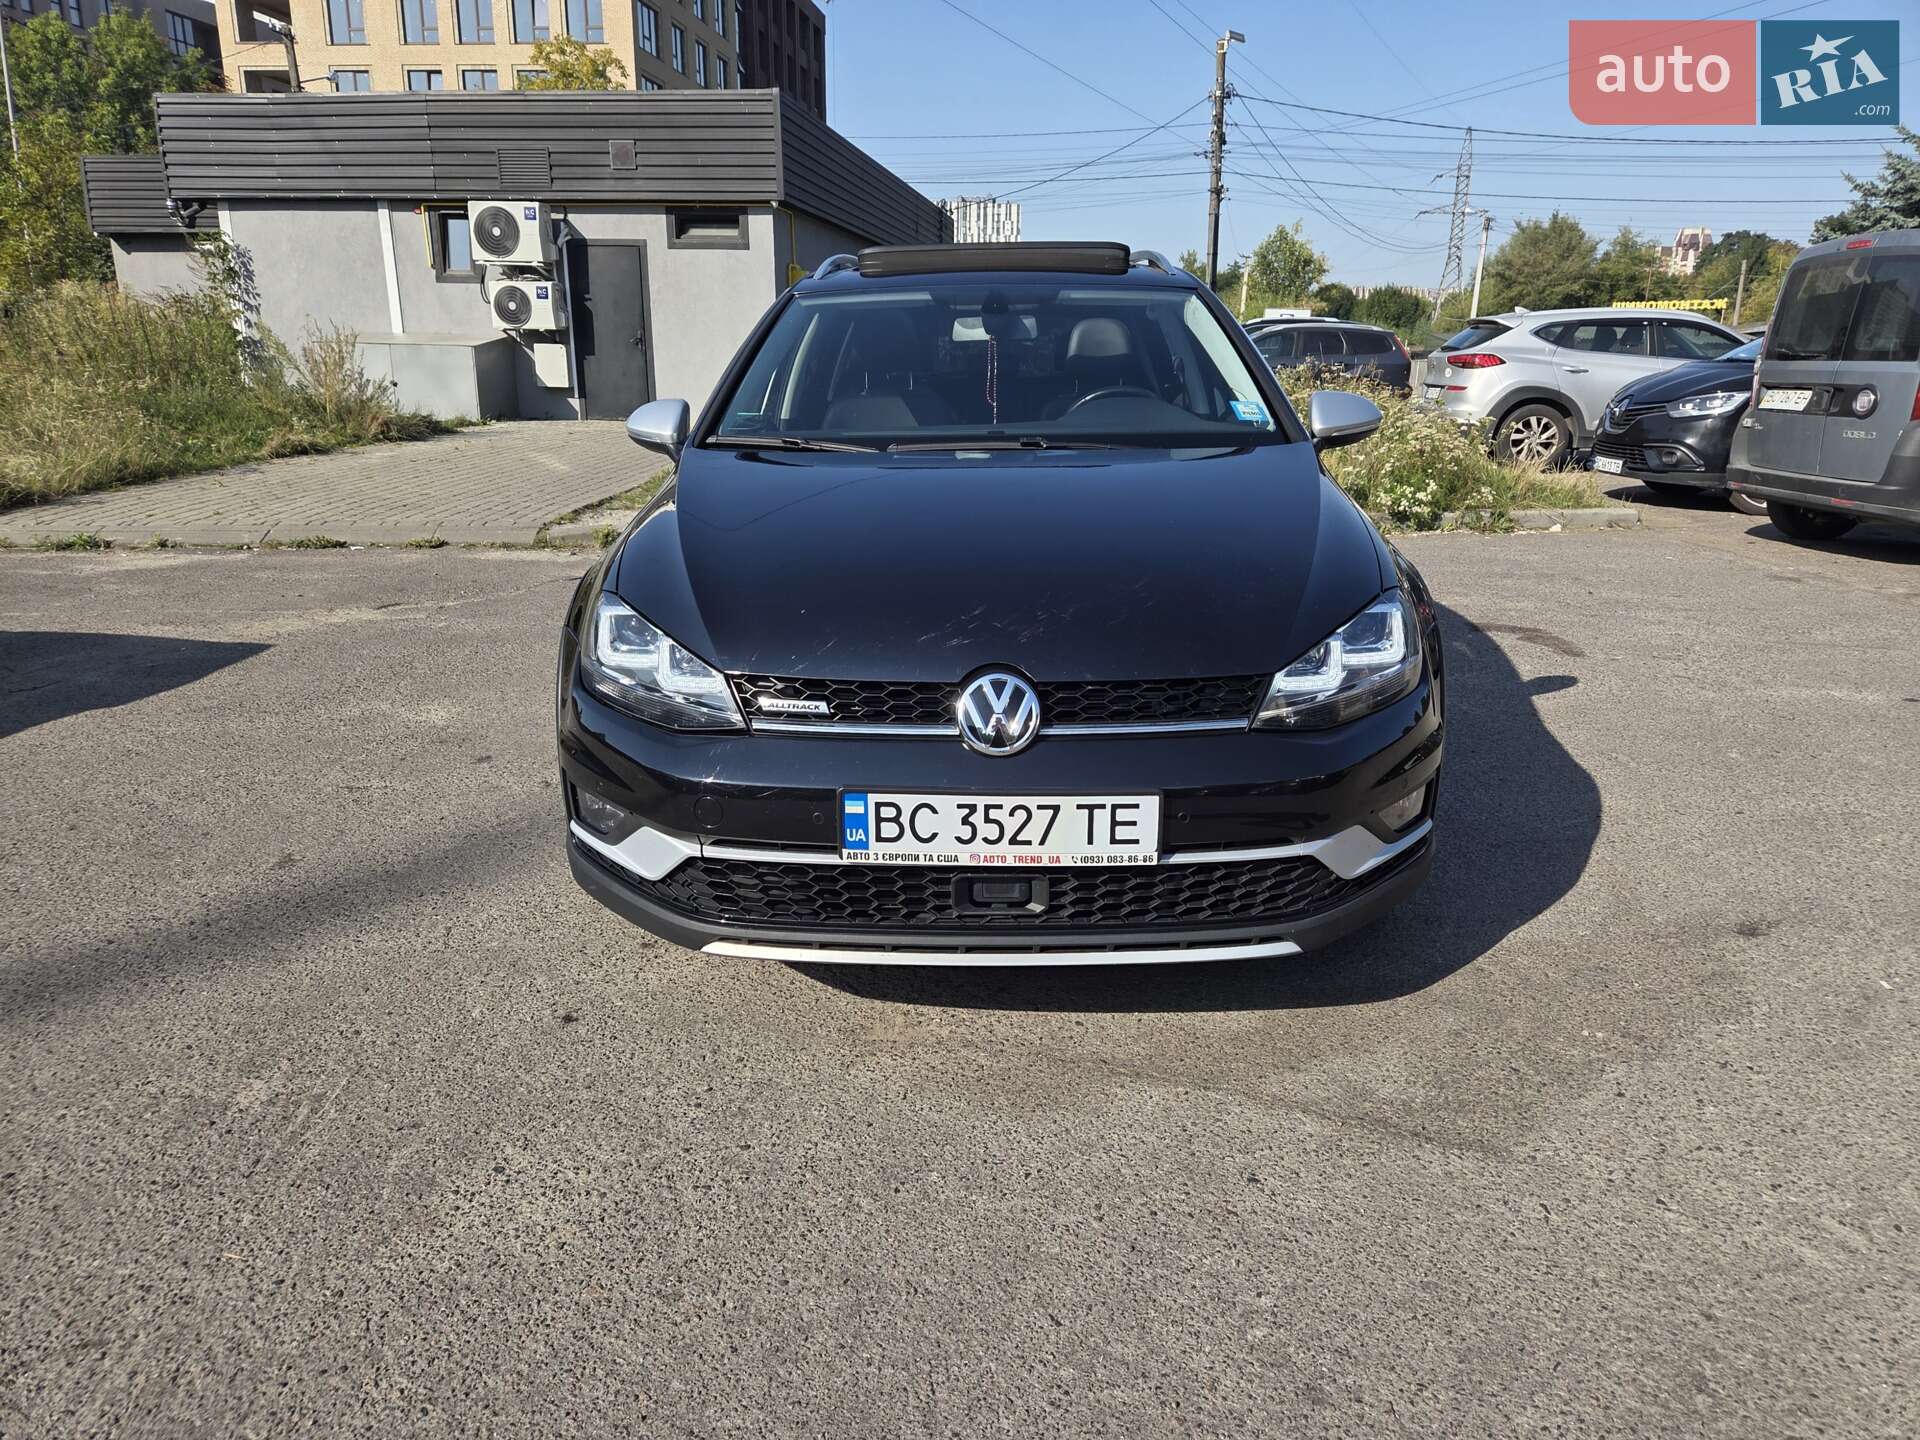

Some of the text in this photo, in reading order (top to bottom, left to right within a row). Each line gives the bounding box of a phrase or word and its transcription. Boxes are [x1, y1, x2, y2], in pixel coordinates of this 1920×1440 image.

[1612, 298, 1728, 310] ШИНОМОНТАЖ
[766, 702, 821, 711] ALLTRACK
[874, 801, 1140, 846] BC 3527 TE
[846, 828, 866, 842] UA
[846, 852, 870, 861] АВТО
[1080, 854, 1103, 864] (093)
